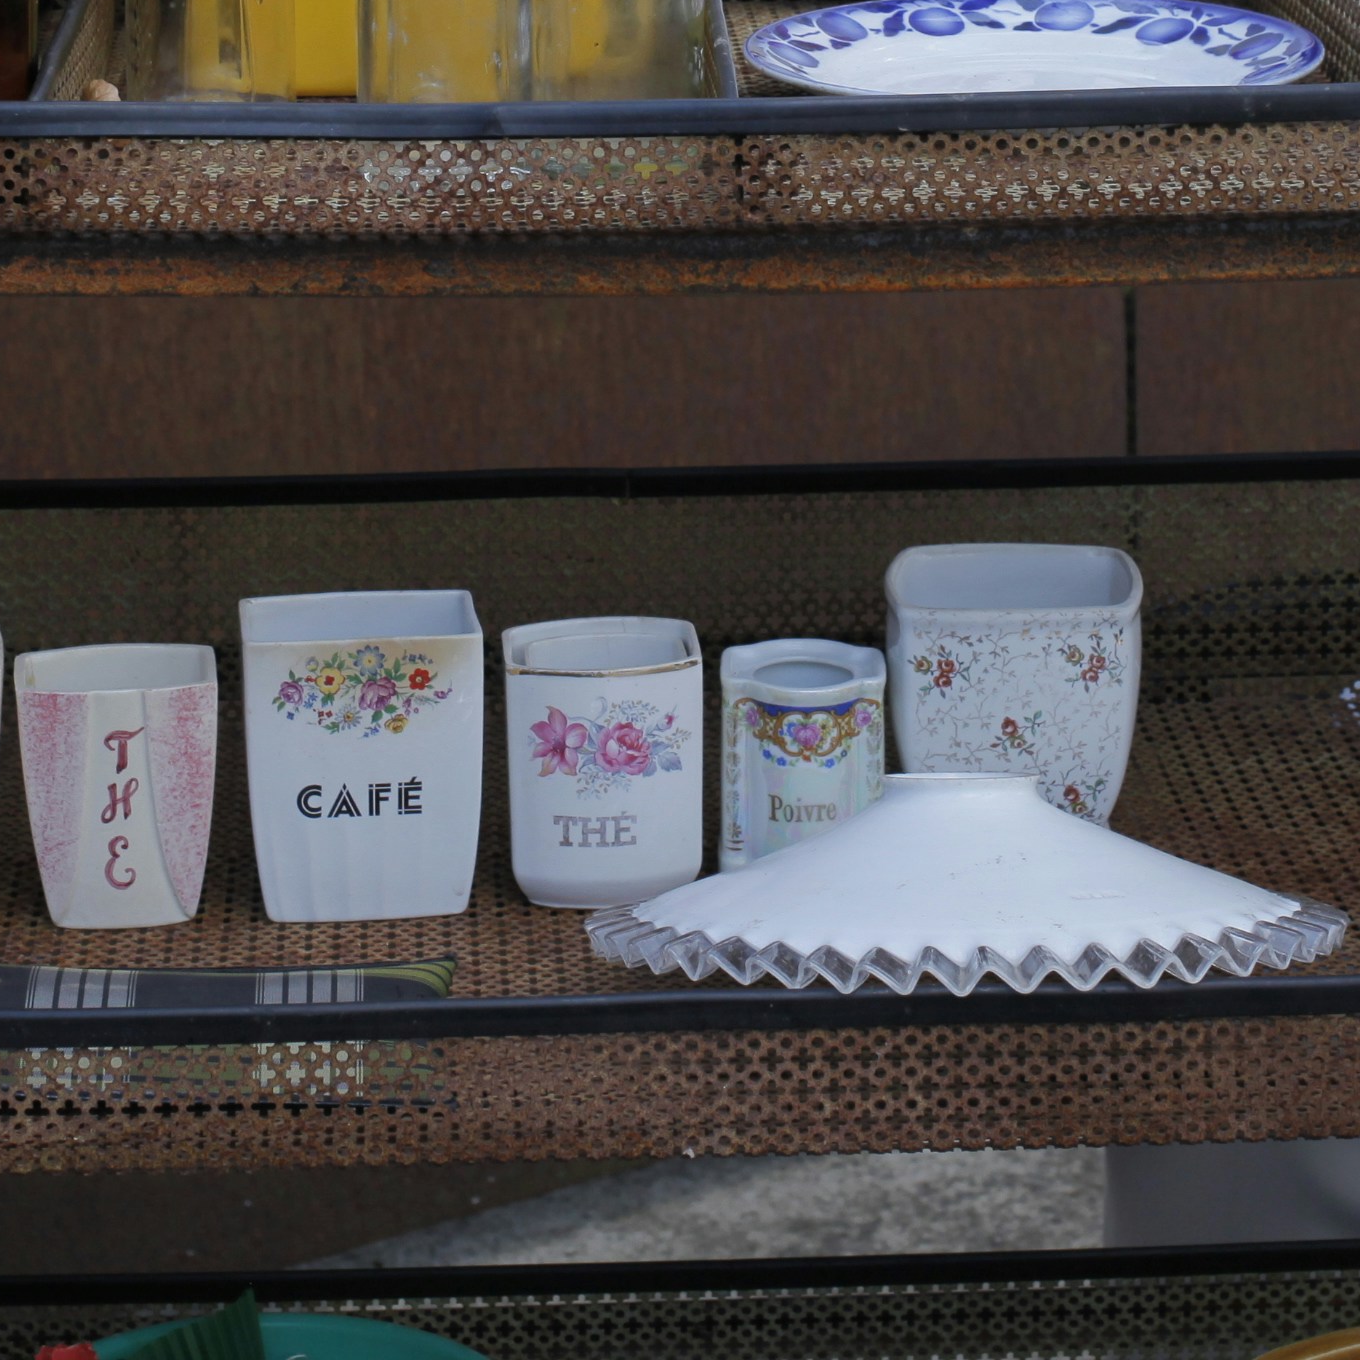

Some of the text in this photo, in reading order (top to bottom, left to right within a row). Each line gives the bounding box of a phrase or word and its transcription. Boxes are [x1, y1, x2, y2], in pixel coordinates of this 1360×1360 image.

[100, 726, 144, 890] THE
[296, 775, 423, 819] CAFÉ
[767, 793, 837, 823] Poivre
[551, 810, 638, 847] THÉ
